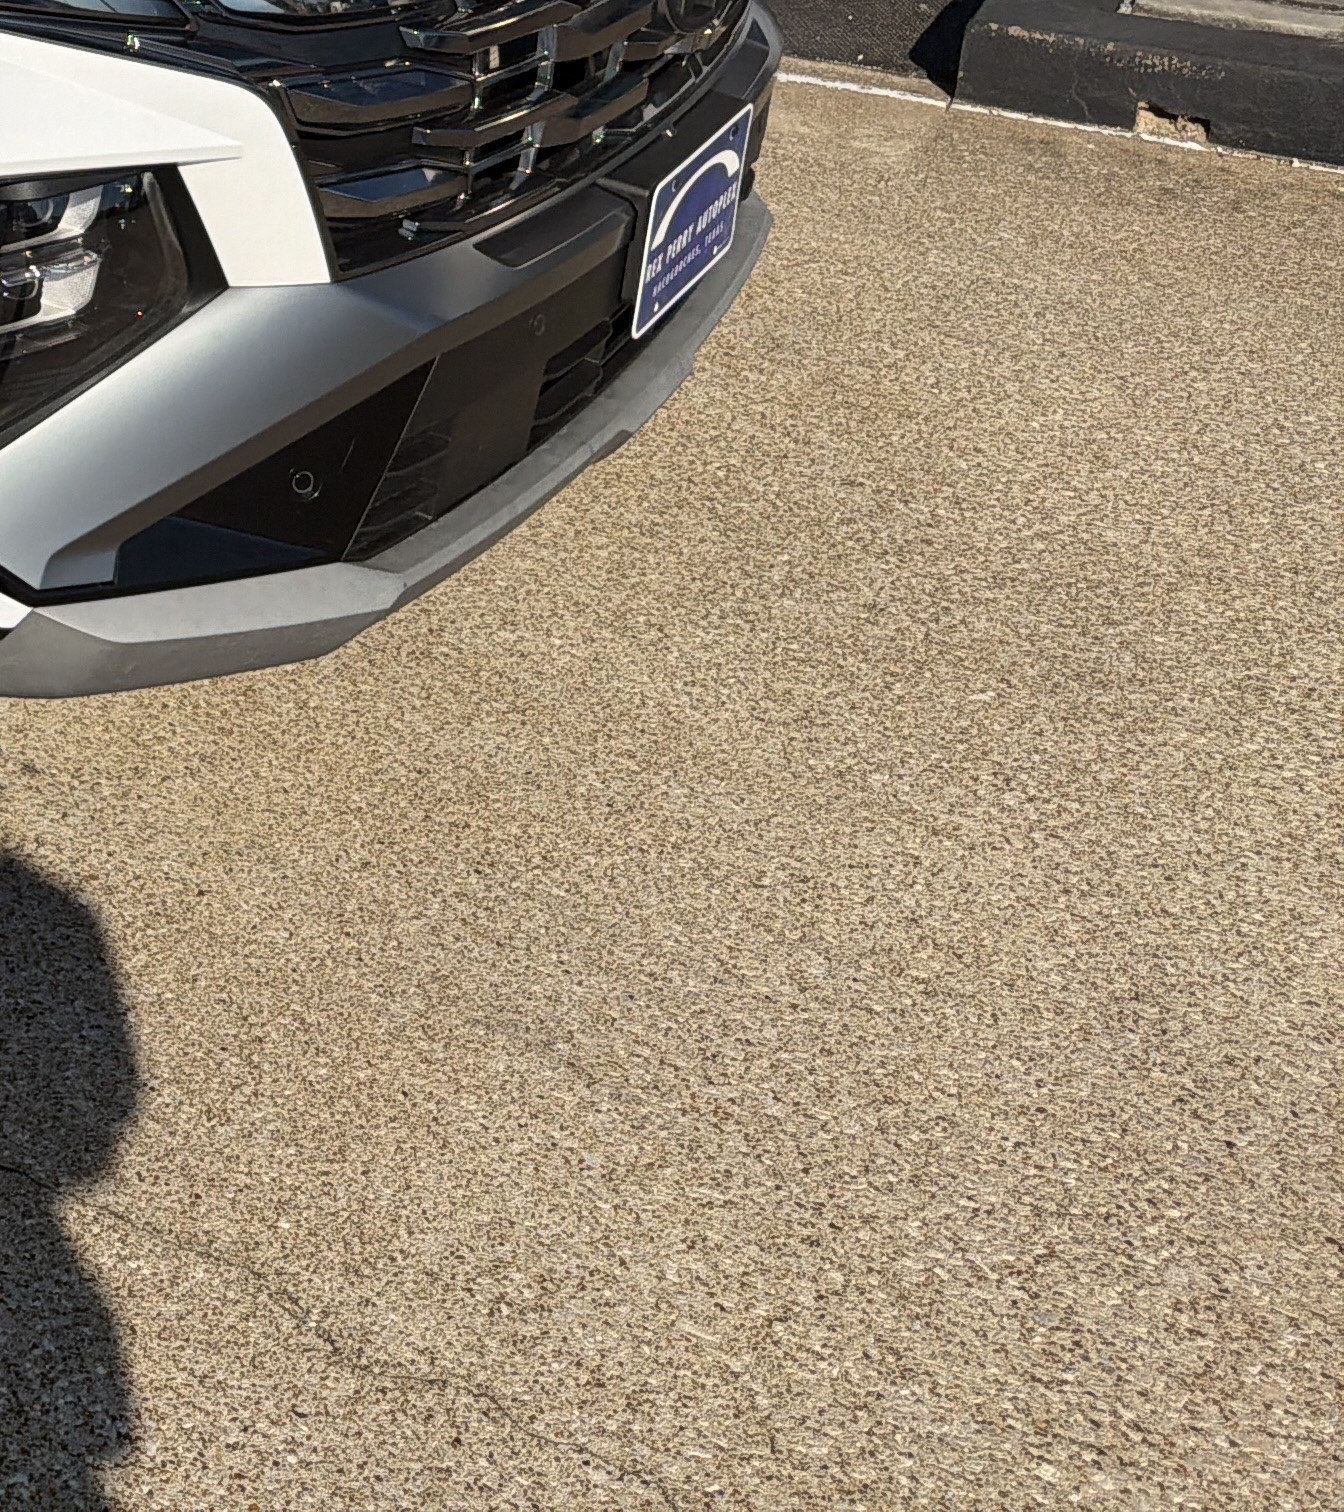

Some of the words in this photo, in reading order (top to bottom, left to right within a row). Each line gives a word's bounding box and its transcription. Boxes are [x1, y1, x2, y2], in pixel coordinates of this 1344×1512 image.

[645, 252, 664, 284] REX
[666, 222, 694, 264] PERRY
[696, 181, 738, 235] AUTOPLEX
